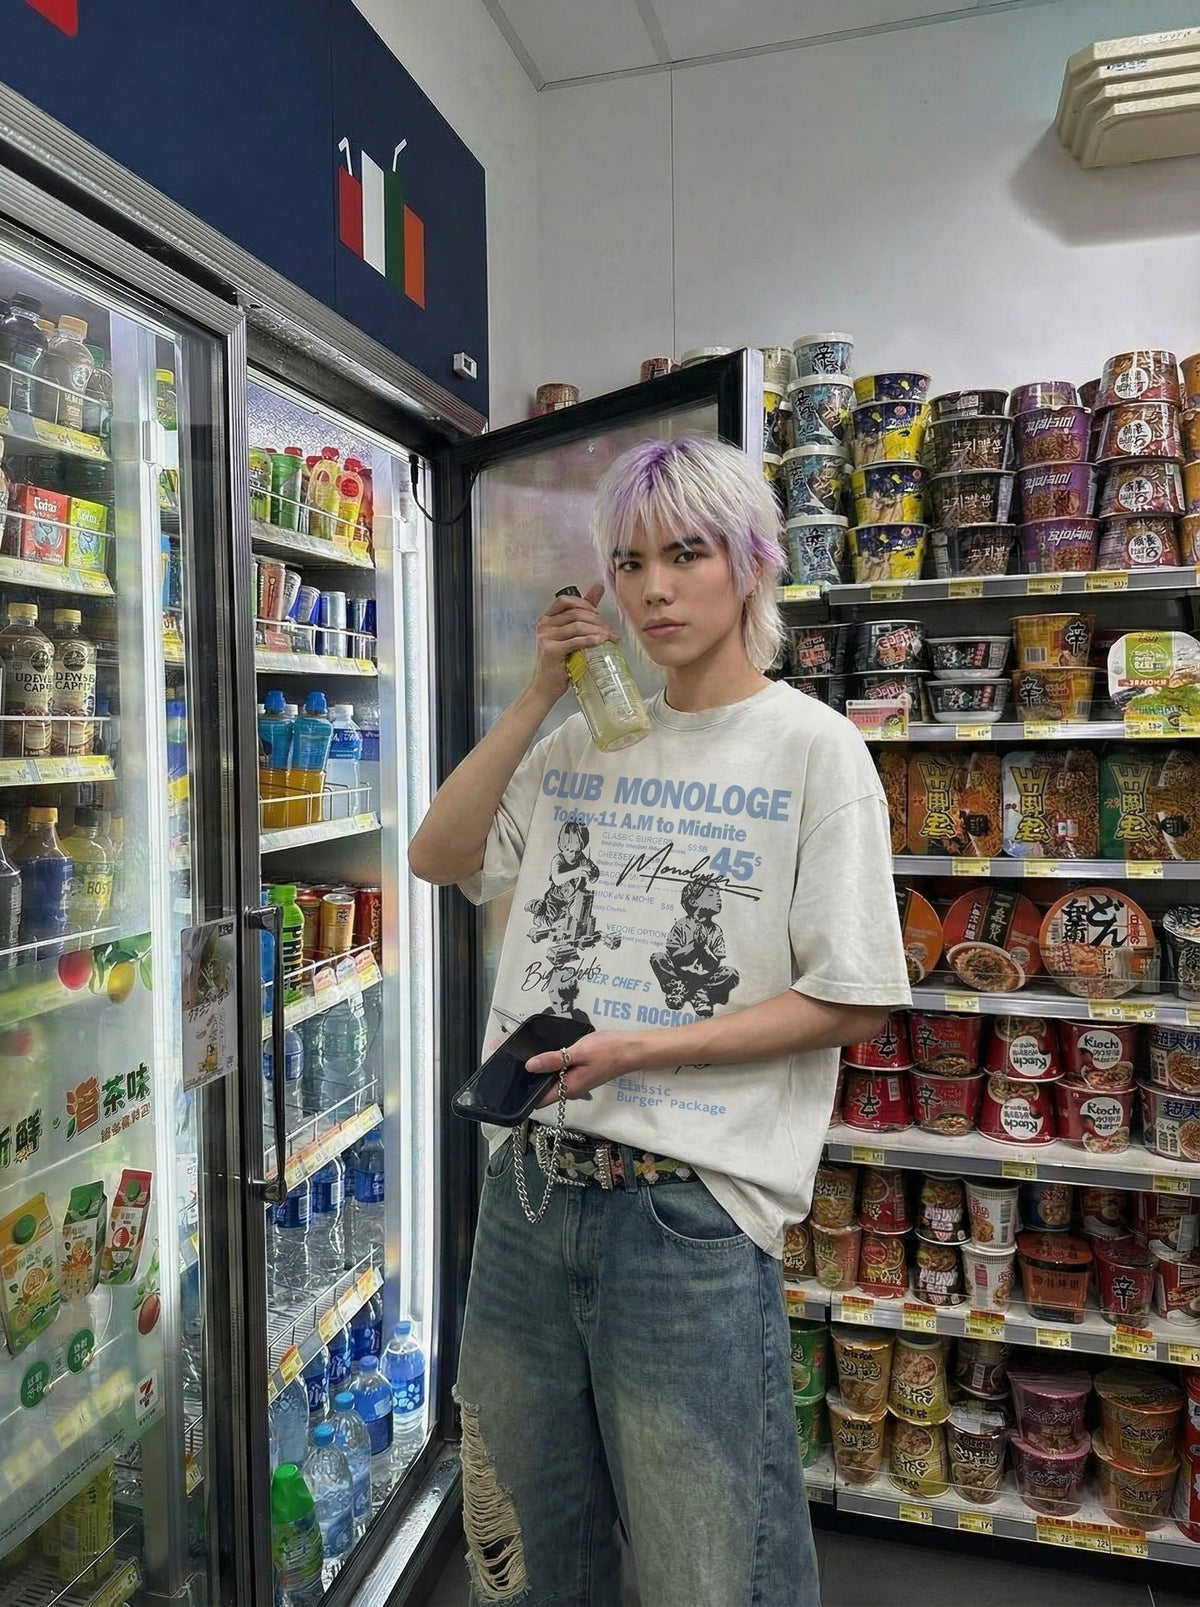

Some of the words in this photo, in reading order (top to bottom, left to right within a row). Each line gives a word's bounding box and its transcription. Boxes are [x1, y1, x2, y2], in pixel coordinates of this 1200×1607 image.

[1065, 621, 1088, 656] 辛
[542, 768, 604, 801] CLUB
[613, 776, 792, 822] MONOLOGE
[657, 817, 674, 833] to
[677, 819, 747, 843] Midnite
[616, 1091, 663, 1107] Burger
[1112, 1276, 1141, 1311] 辛
